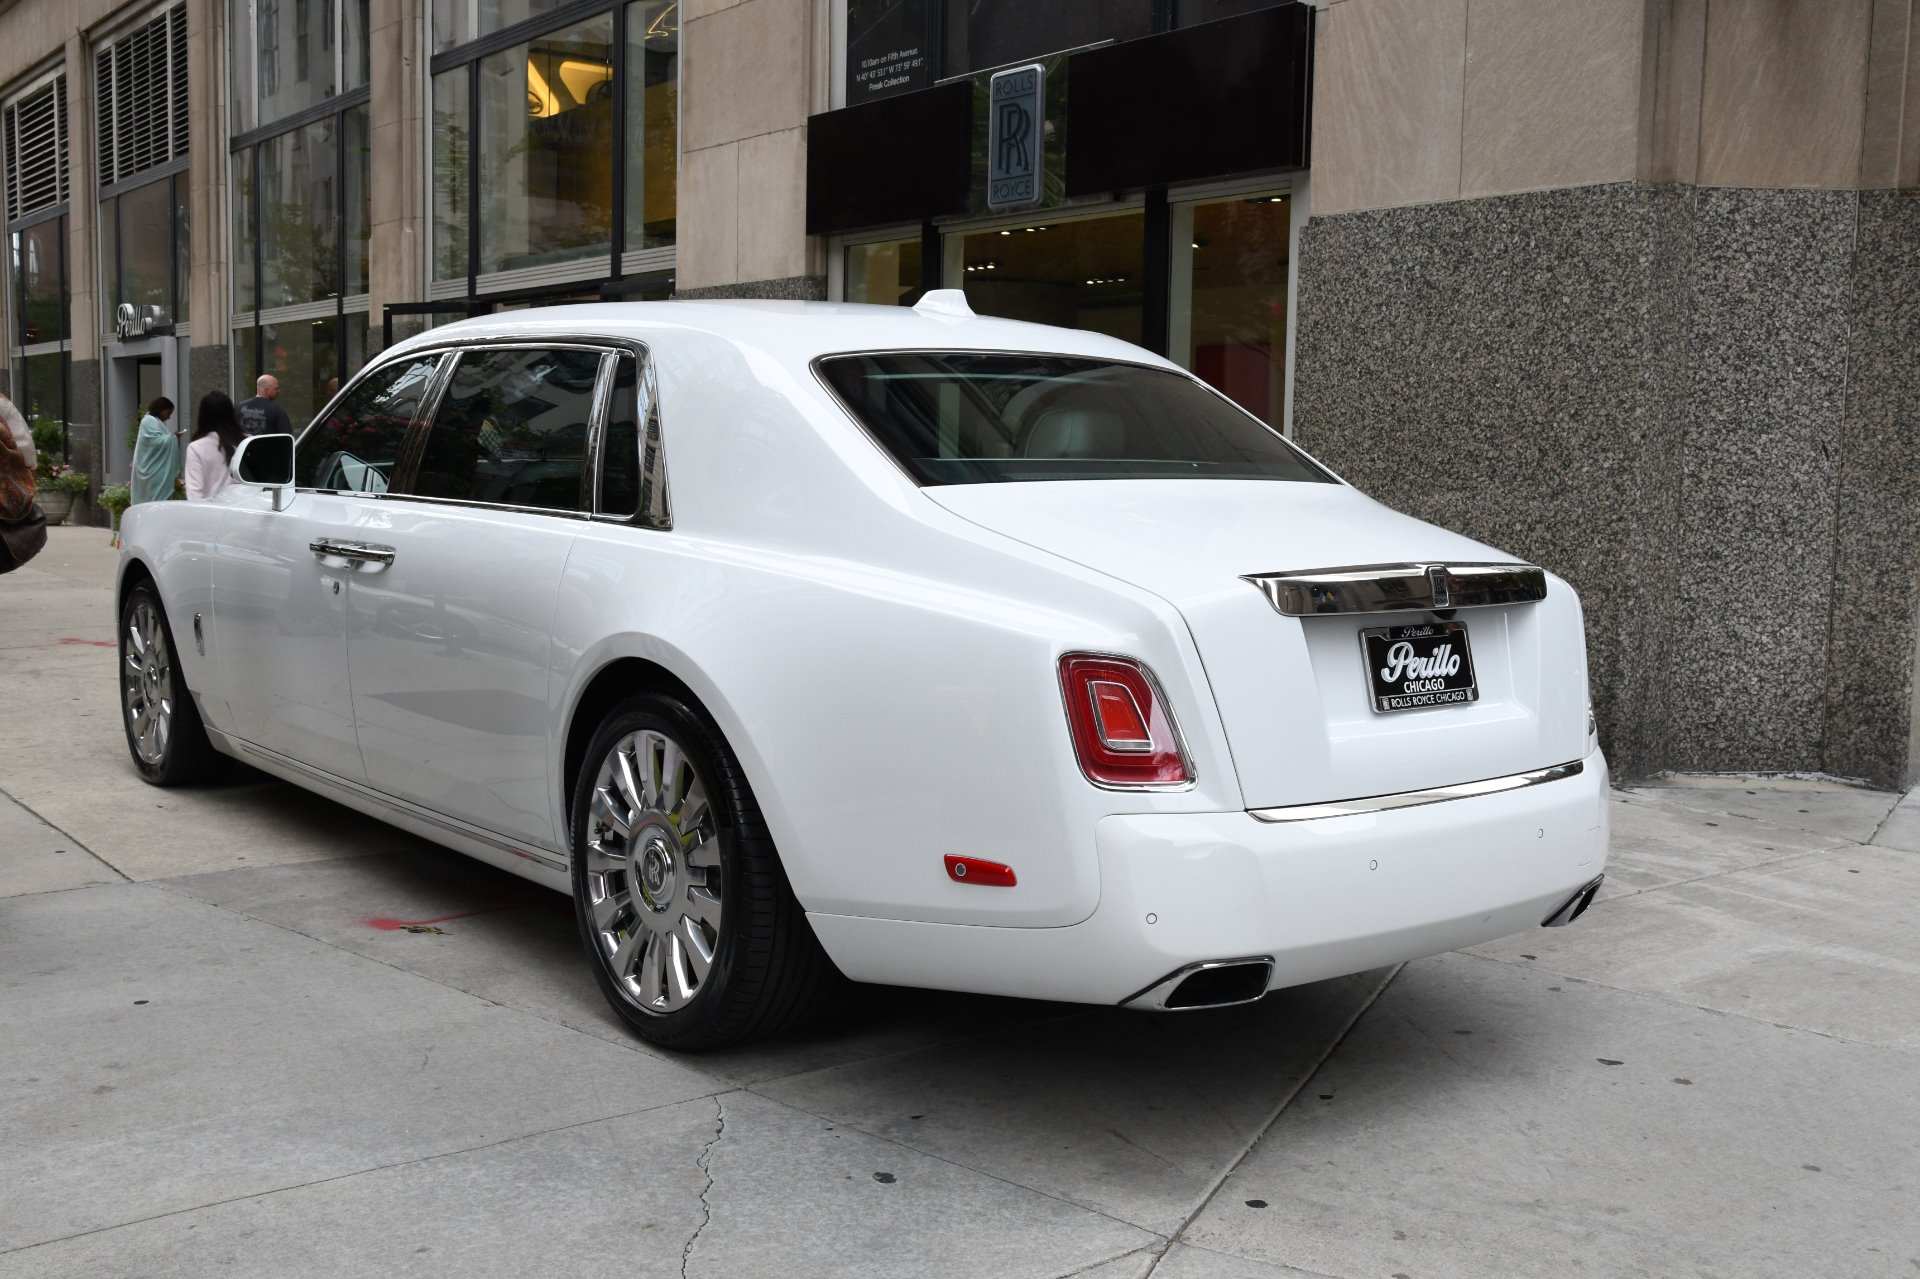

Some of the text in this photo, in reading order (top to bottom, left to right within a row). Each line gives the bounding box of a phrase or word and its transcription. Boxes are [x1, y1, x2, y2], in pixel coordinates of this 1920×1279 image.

[880, 56, 887, 64] on
[887, 51, 899, 61] Fifth
[856, 74, 861, 82] N
[888, 65, 894, 74] W
[868, 75, 910, 91] Freak Collection
[995, 75, 1034, 97] ROLLS
[993, 179, 1031, 199] ROYCE
[117, 303, 146, 338] Perillo
[1401, 625, 1434, 638] Perillo
[1381, 641, 1460, 683] Perillo
[1403, 678, 1445, 693] CHICAGO
[1391, 697, 1412, 708] ROLLS
[1413, 694, 1435, 706] ROYCE
[1436, 691, 1465, 703] CHICAGO
